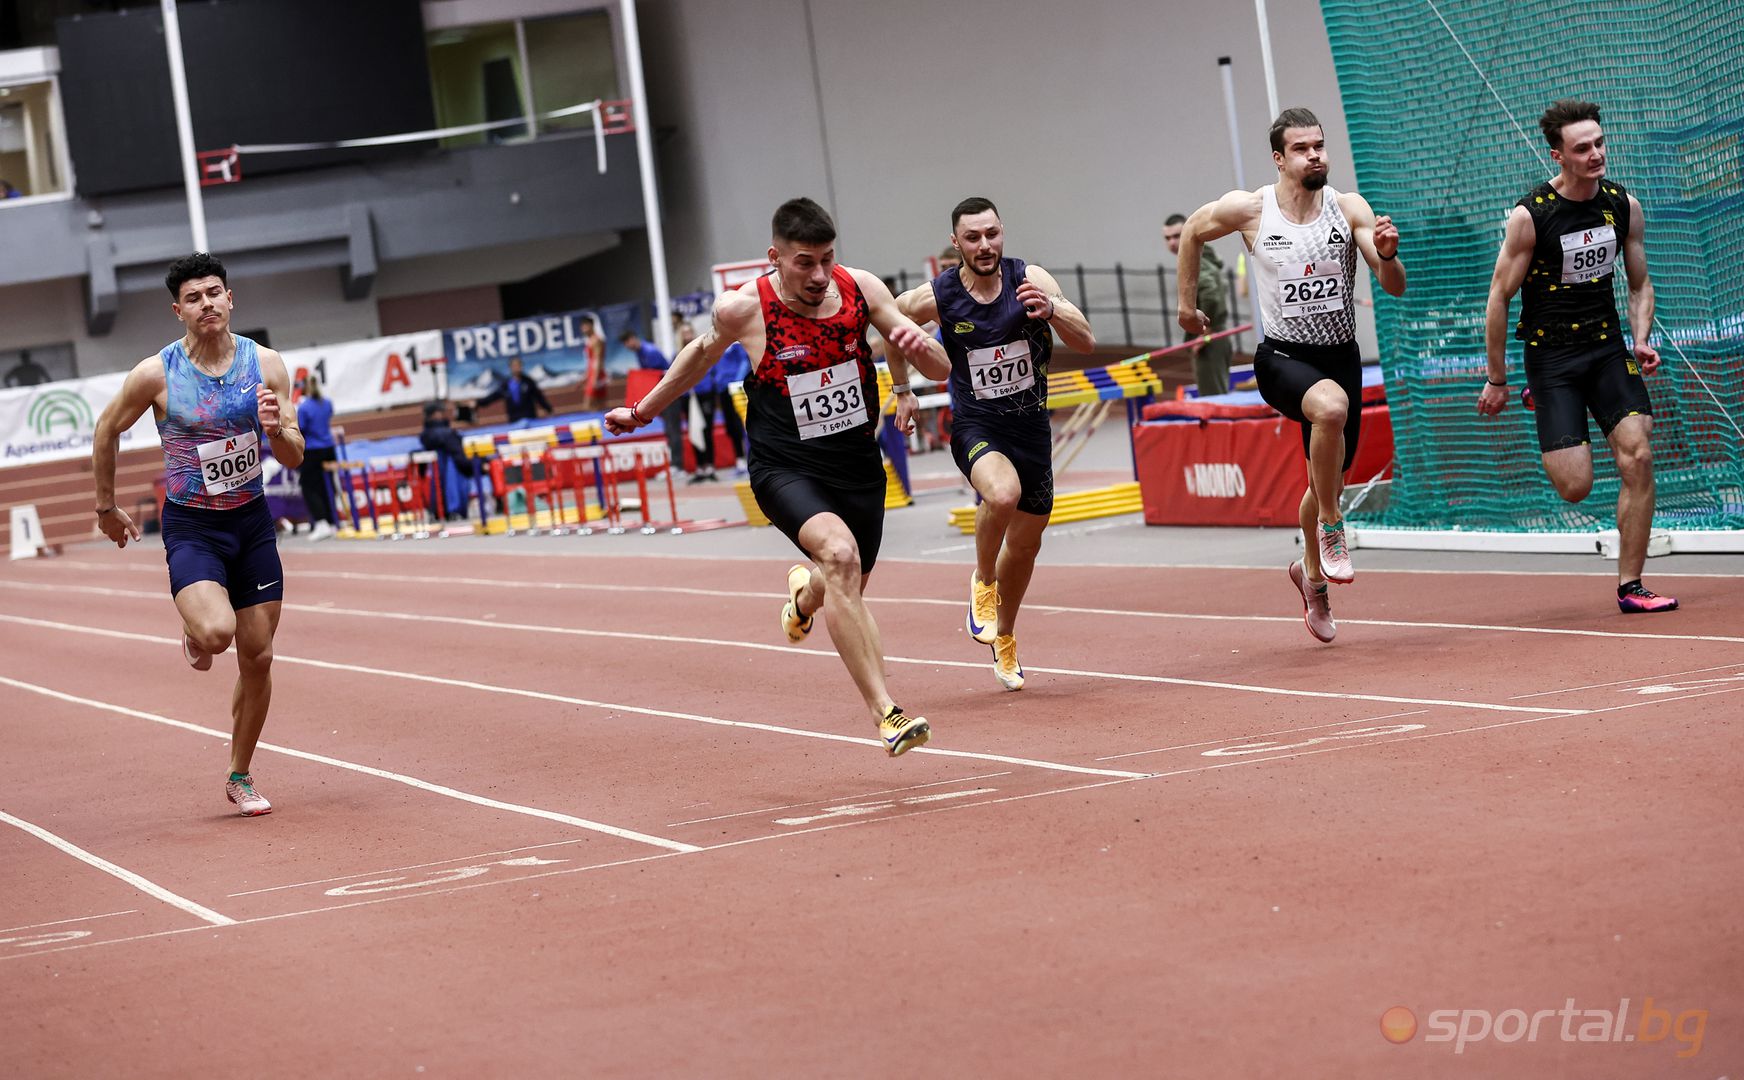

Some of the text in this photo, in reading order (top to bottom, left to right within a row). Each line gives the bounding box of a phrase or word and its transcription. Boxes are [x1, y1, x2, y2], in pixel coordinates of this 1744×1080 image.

[1573, 246, 1607, 270] 589
[1283, 278, 1339, 303] 2622
[381, 345, 418, 394] A1
[976, 358, 1029, 387] 1970
[799, 385, 860, 421] 1333
[829, 418, 853, 432] БФЛА
[206, 448, 256, 481] 3060
[22, 516, 31, 541] 1
